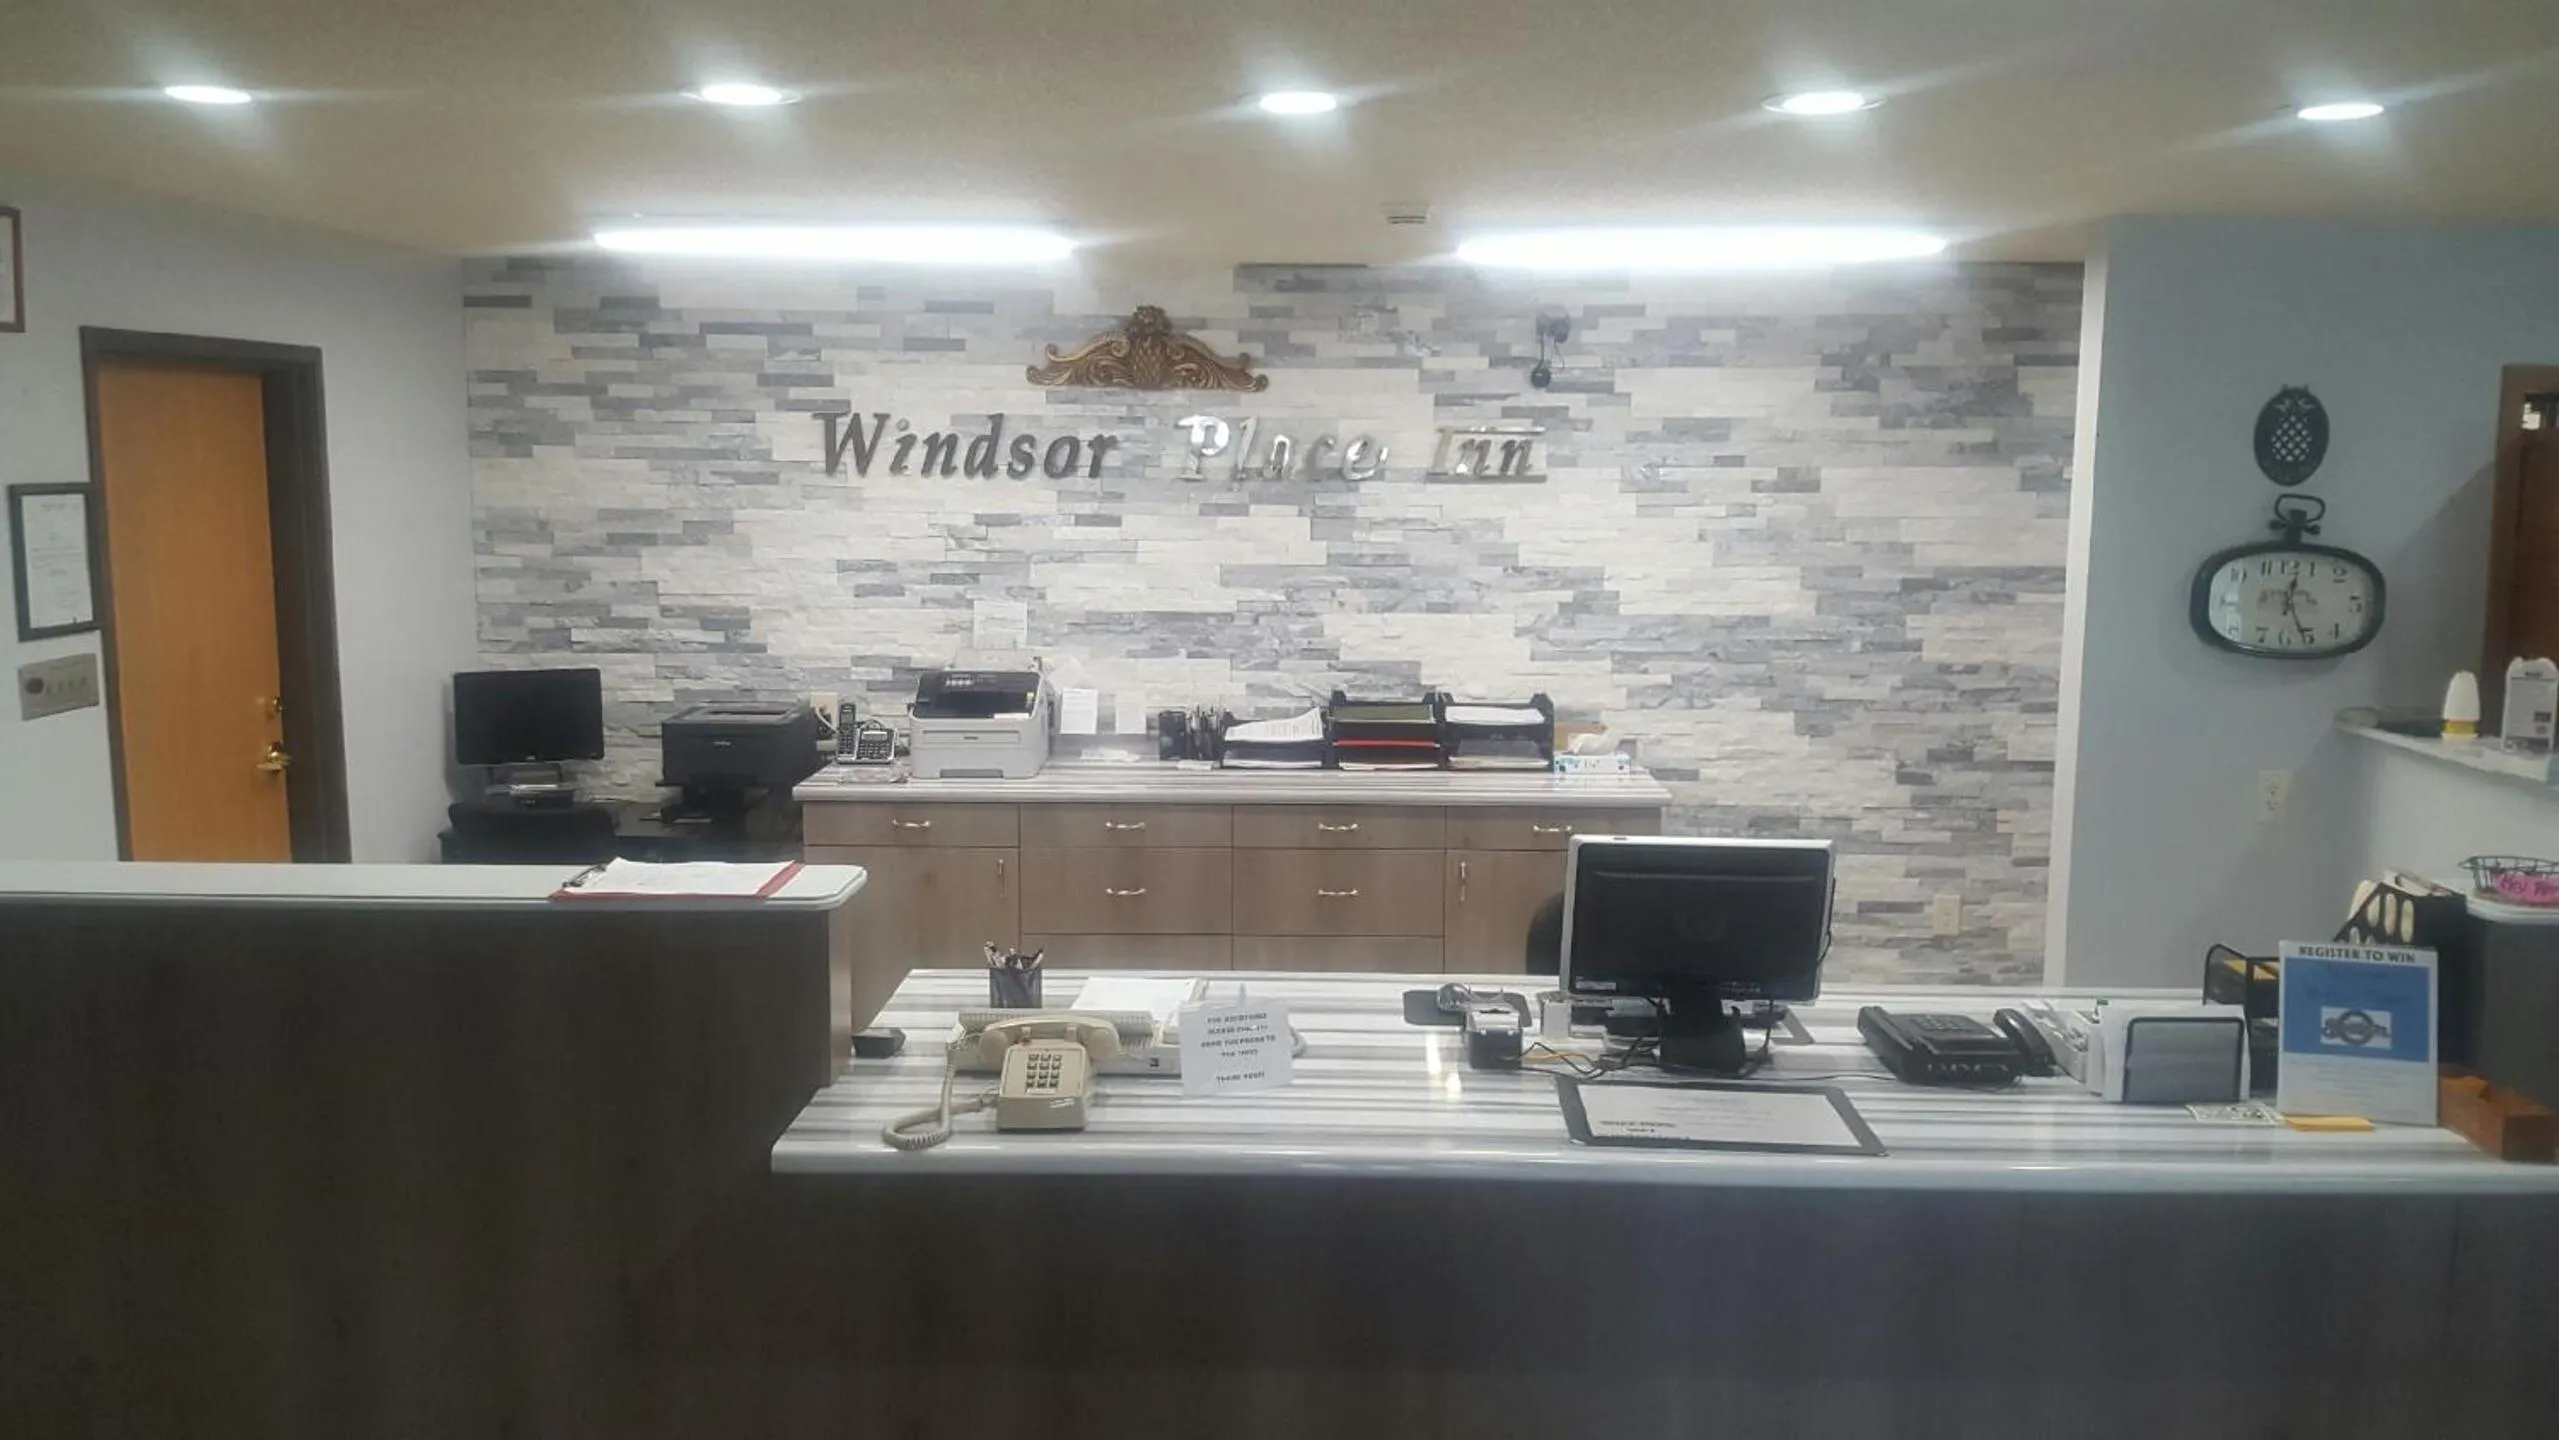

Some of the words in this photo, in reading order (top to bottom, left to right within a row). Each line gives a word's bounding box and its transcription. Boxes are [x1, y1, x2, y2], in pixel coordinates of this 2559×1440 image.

[811, 411, 1118, 480] Windsor
[1176, 414, 1389, 491] Place
[1426, 425, 1548, 483] Inn
[2280, 560, 2301, 576] 12
[2298, 946, 2360, 959] REGISTER
[2364, 950, 2383, 961] TO
[2387, 951, 2416, 963] WIN
